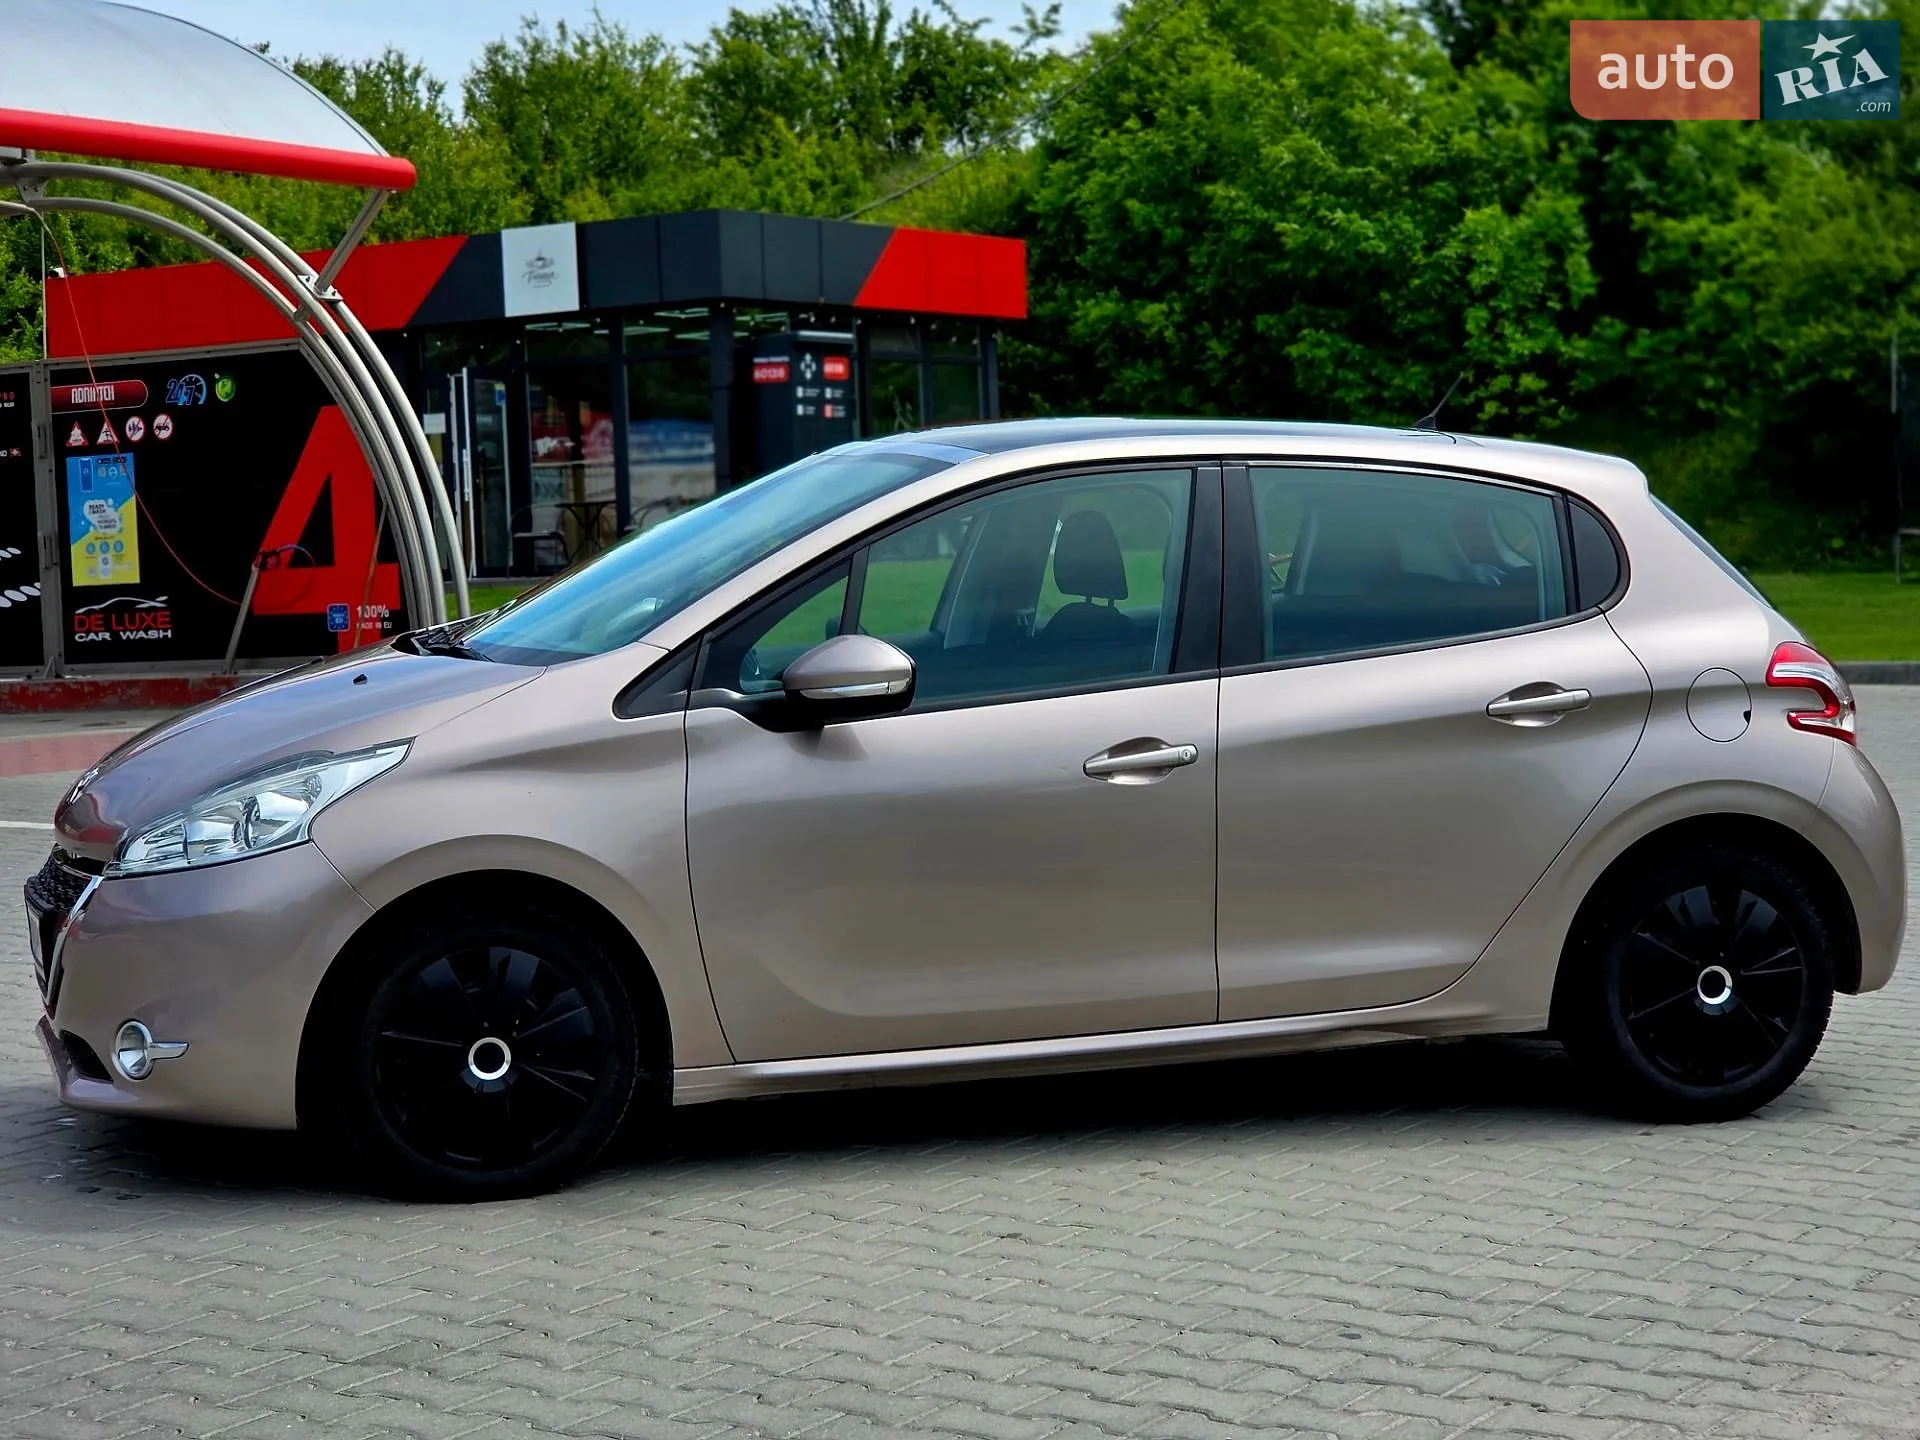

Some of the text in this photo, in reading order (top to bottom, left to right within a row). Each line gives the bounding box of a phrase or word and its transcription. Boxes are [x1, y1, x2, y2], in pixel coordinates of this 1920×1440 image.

[252, 405, 400, 655] 4
[73, 611, 172, 632] DE LUXE
[383, 621, 392, 629] EU
[74, 629, 172, 642] CAR WASH
